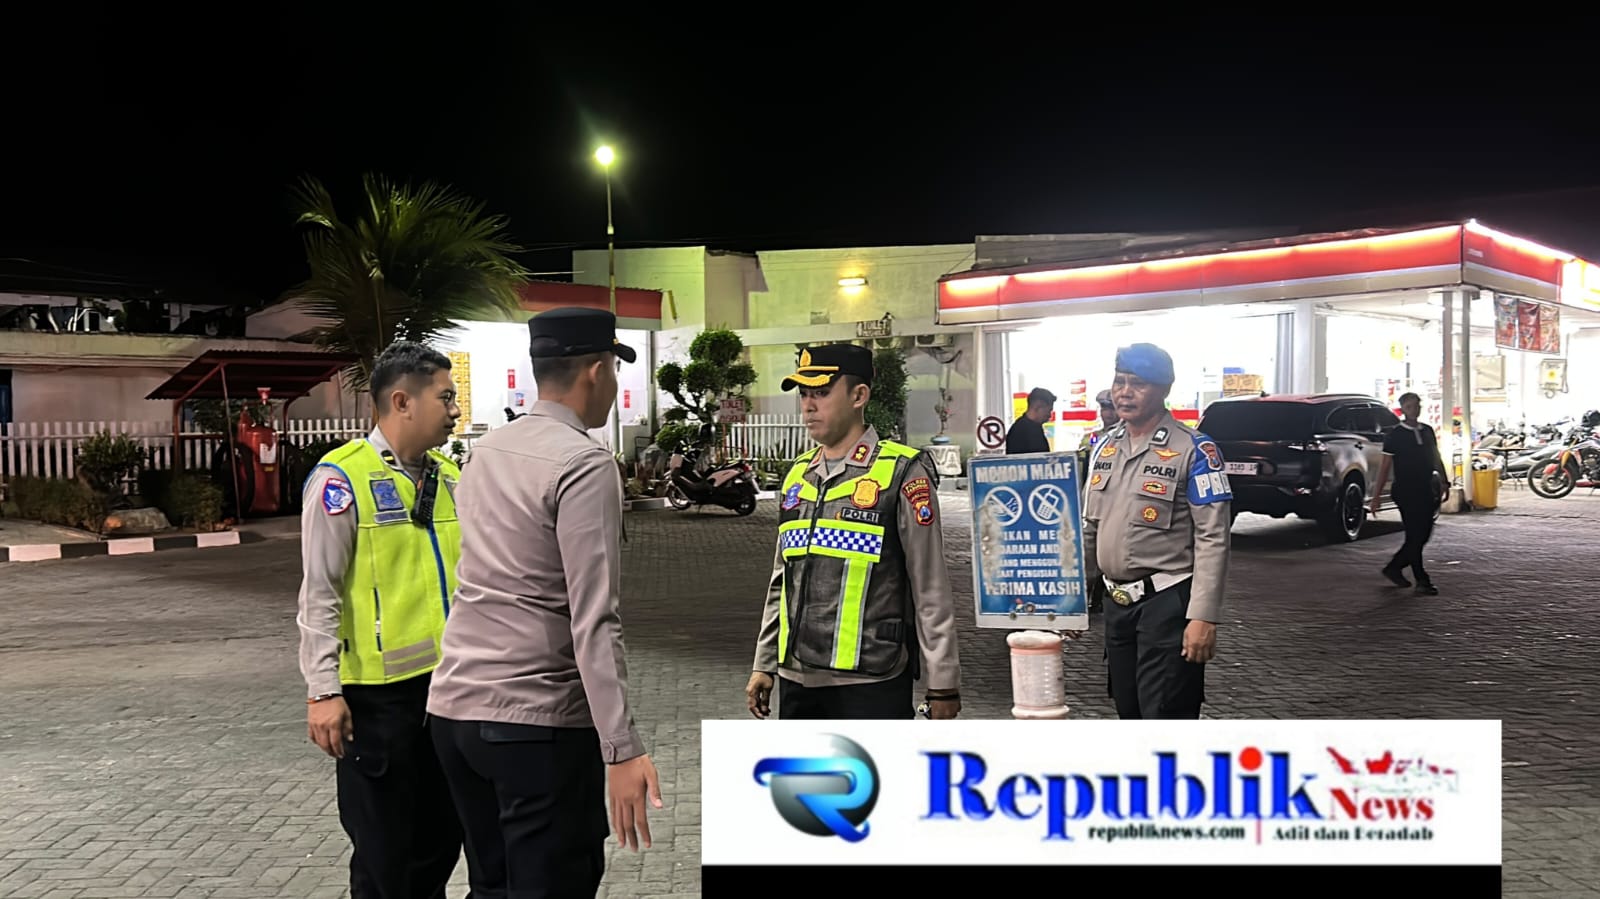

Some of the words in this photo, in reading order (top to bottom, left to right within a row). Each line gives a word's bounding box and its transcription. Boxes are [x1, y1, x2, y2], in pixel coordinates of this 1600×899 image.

[975, 465, 1028, 483] MOHON
[1030, 463, 1071, 480] MAAF
[1143, 465, 1177, 478] POLRI
[843, 510, 879, 523] POLRI
[984, 581, 1035, 596] TERIMA
[1038, 581, 1081, 595] KASIH
